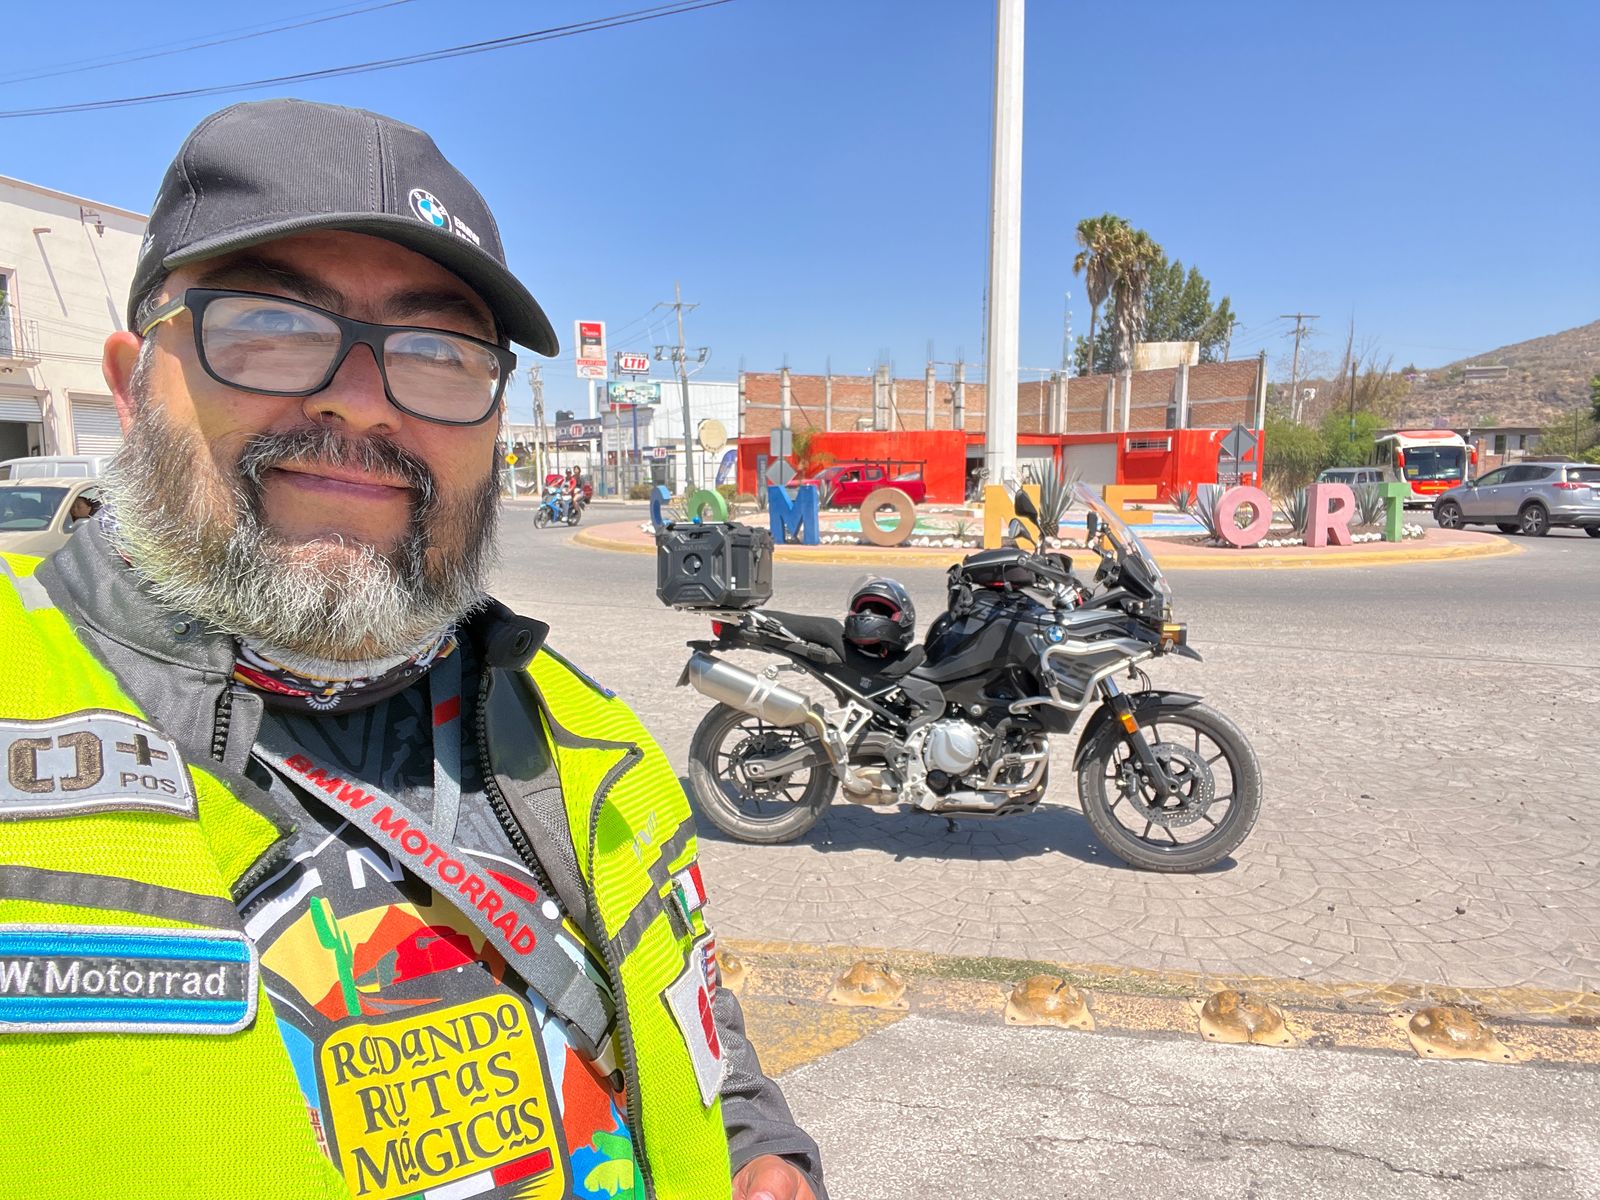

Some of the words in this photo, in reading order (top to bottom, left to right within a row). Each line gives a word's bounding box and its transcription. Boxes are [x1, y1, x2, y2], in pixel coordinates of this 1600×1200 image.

[624, 358, 647, 369] LTH
[120, 772, 178, 794] POS
[282, 753, 376, 810] BMW
[371, 806, 537, 956] MOTORRAD
[45, 961, 226, 996] Motorrad
